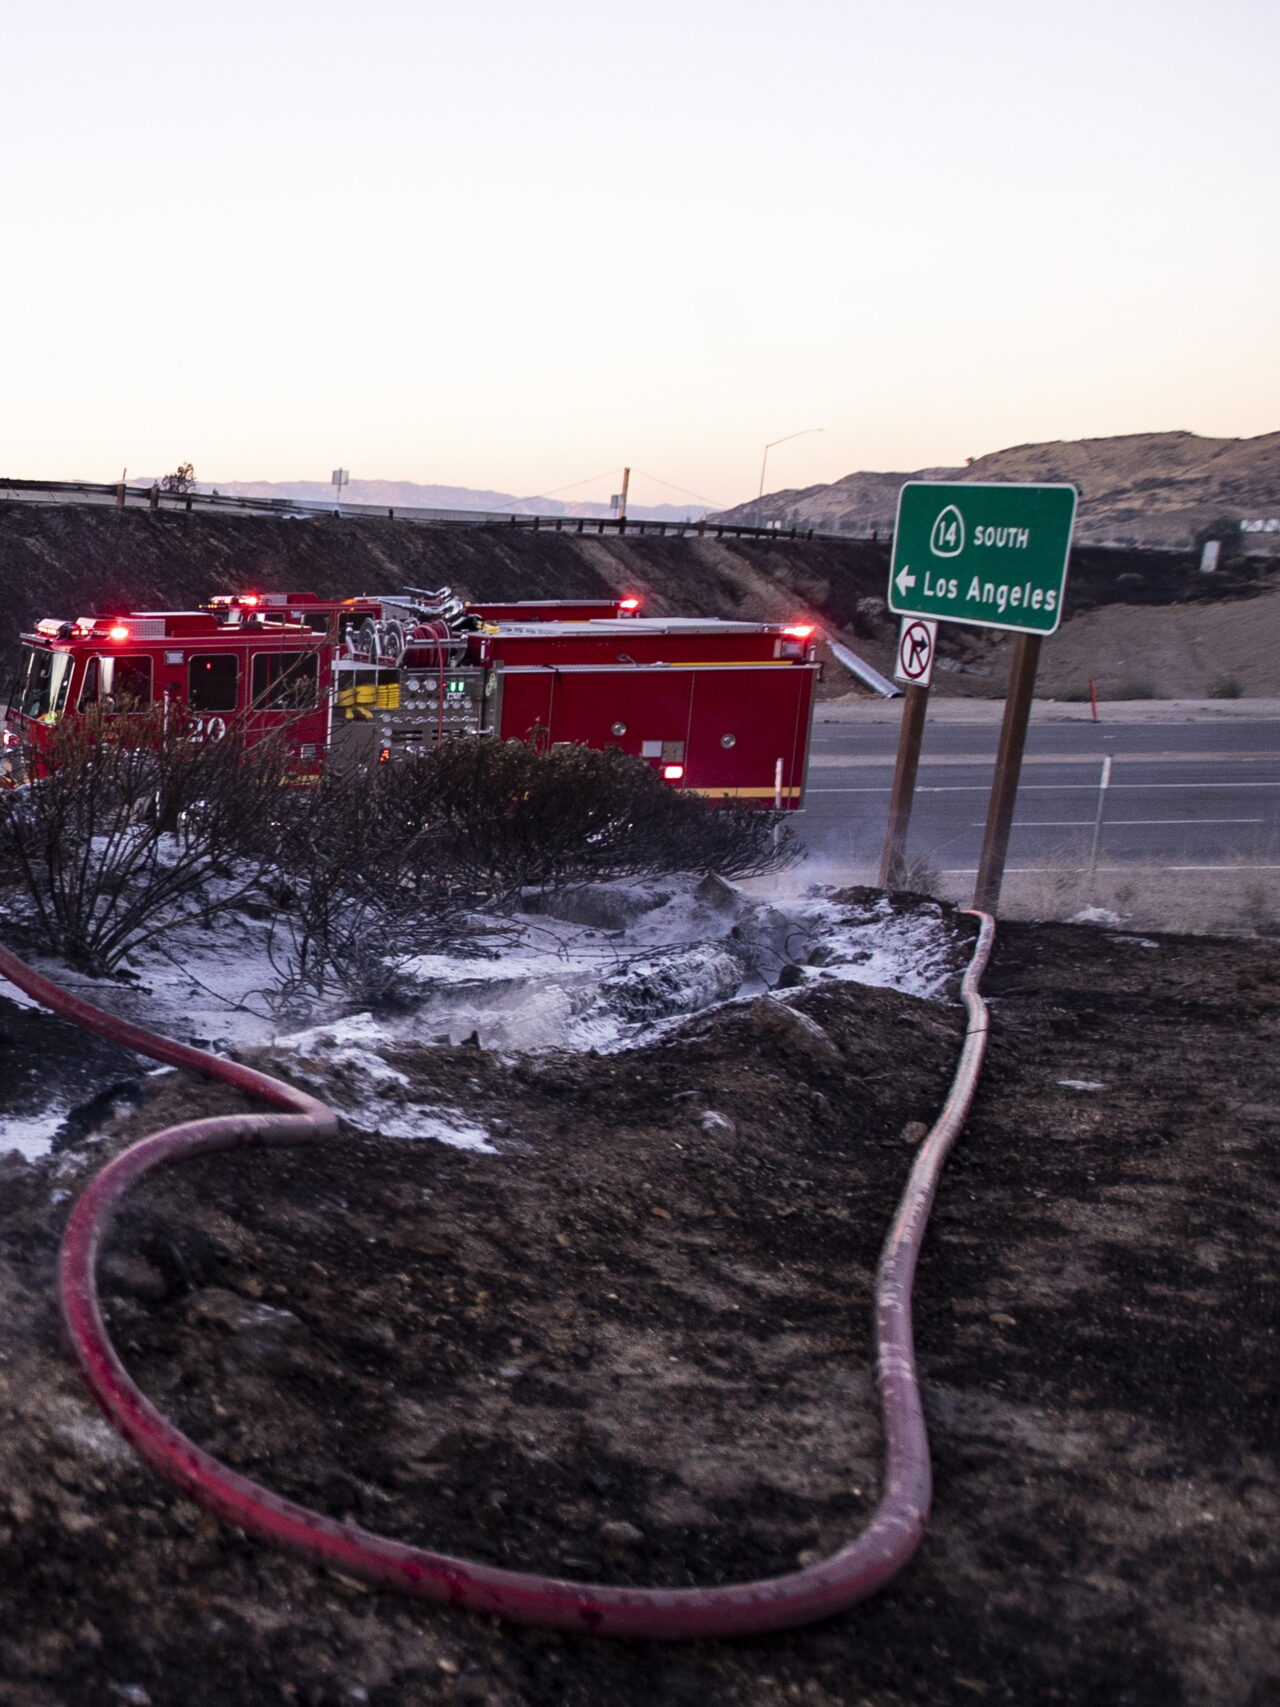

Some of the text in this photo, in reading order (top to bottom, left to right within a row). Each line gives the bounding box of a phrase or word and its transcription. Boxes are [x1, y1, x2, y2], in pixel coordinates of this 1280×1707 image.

[938, 521, 1030, 549] 14 SOUTH
[923, 570, 1057, 614] Los Angeles
[186, 716, 226, 743] 20
